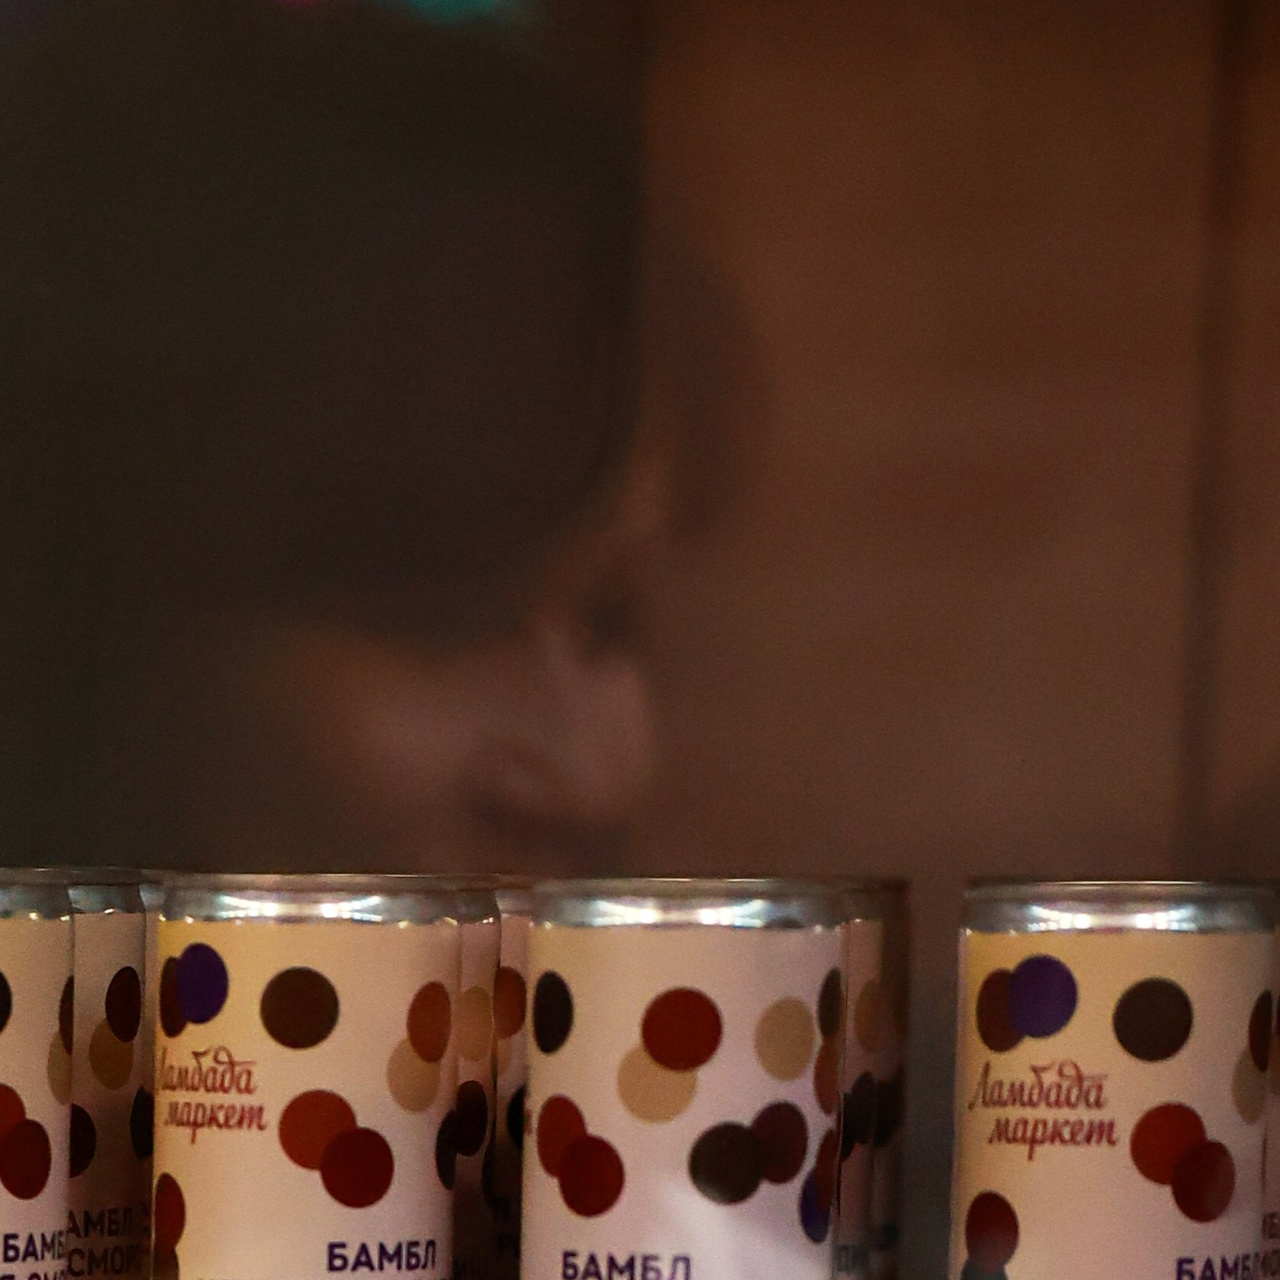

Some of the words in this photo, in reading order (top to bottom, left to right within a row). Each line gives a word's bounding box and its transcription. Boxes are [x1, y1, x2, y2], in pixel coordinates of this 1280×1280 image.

[968, 1060, 1109, 1109] Ламбада
[988, 1117, 1118, 1161] маркет
[327, 1239, 436, 1272] БАМБЛ
